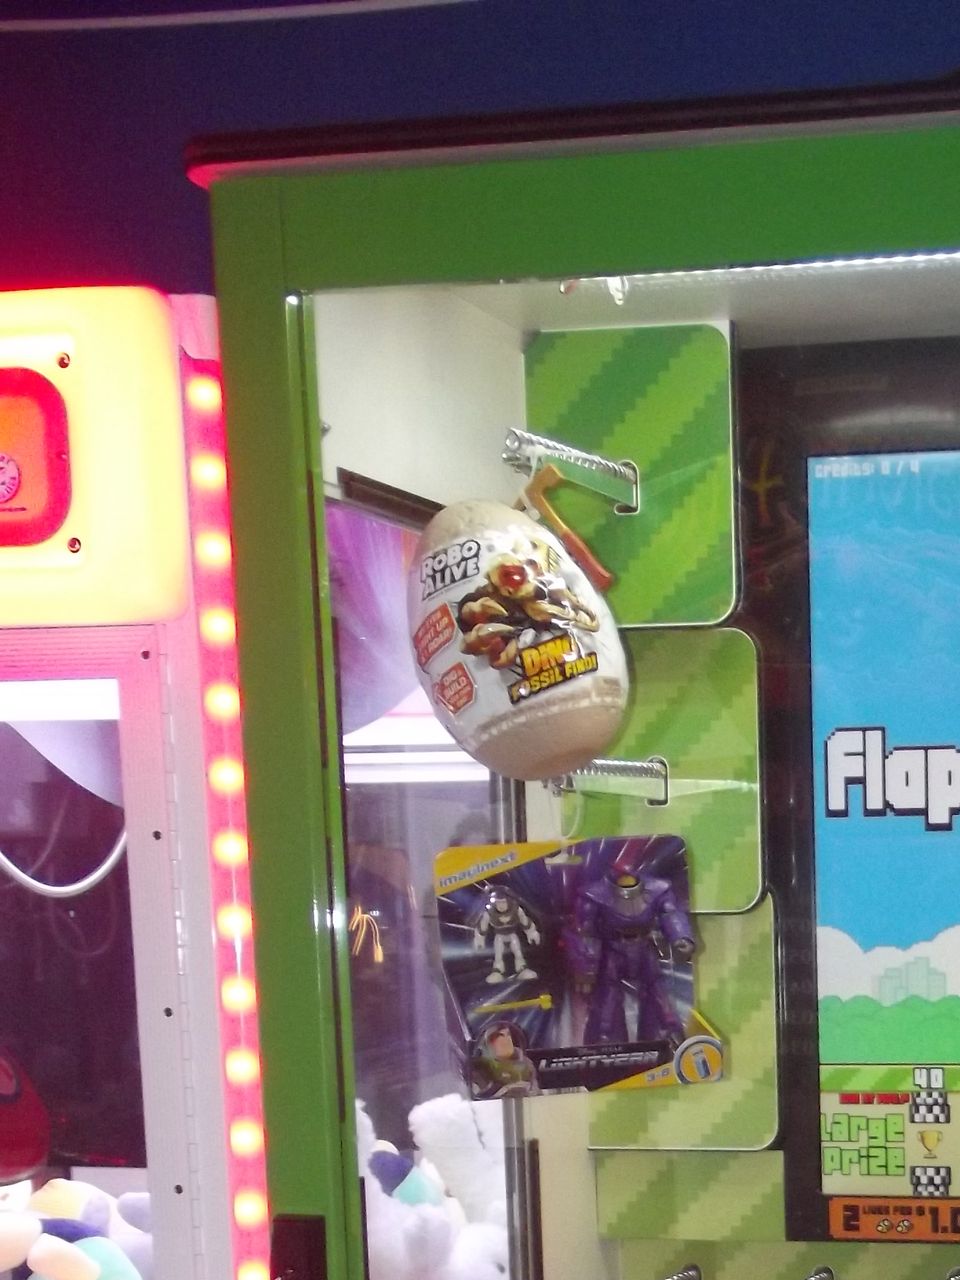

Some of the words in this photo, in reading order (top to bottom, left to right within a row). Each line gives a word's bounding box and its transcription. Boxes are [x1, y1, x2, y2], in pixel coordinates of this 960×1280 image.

[421, 540, 481, 582] ROBO
[422, 557, 480, 600] ALIVE
[440, 852, 516, 888] imaginext
[913, 1066, 945, 1090] 40
[842, 1204, 861, 1232] 2
